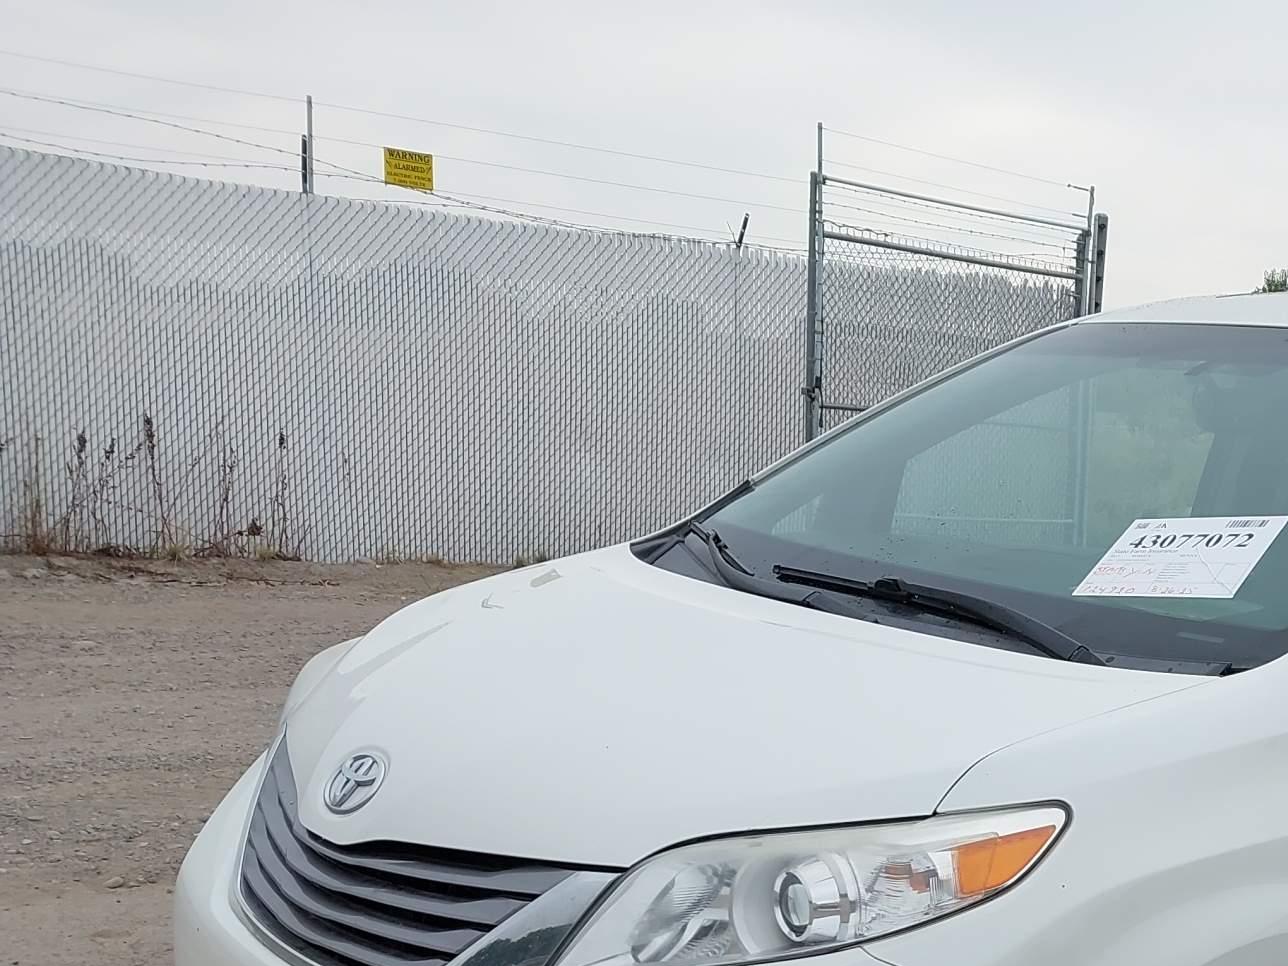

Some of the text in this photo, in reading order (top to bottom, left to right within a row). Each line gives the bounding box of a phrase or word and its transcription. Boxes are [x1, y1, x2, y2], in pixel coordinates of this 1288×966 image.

[387, 149, 430, 163] WARNING
[394, 163, 425, 173] ALARMED
[1129, 533, 1254, 549] 43077072
